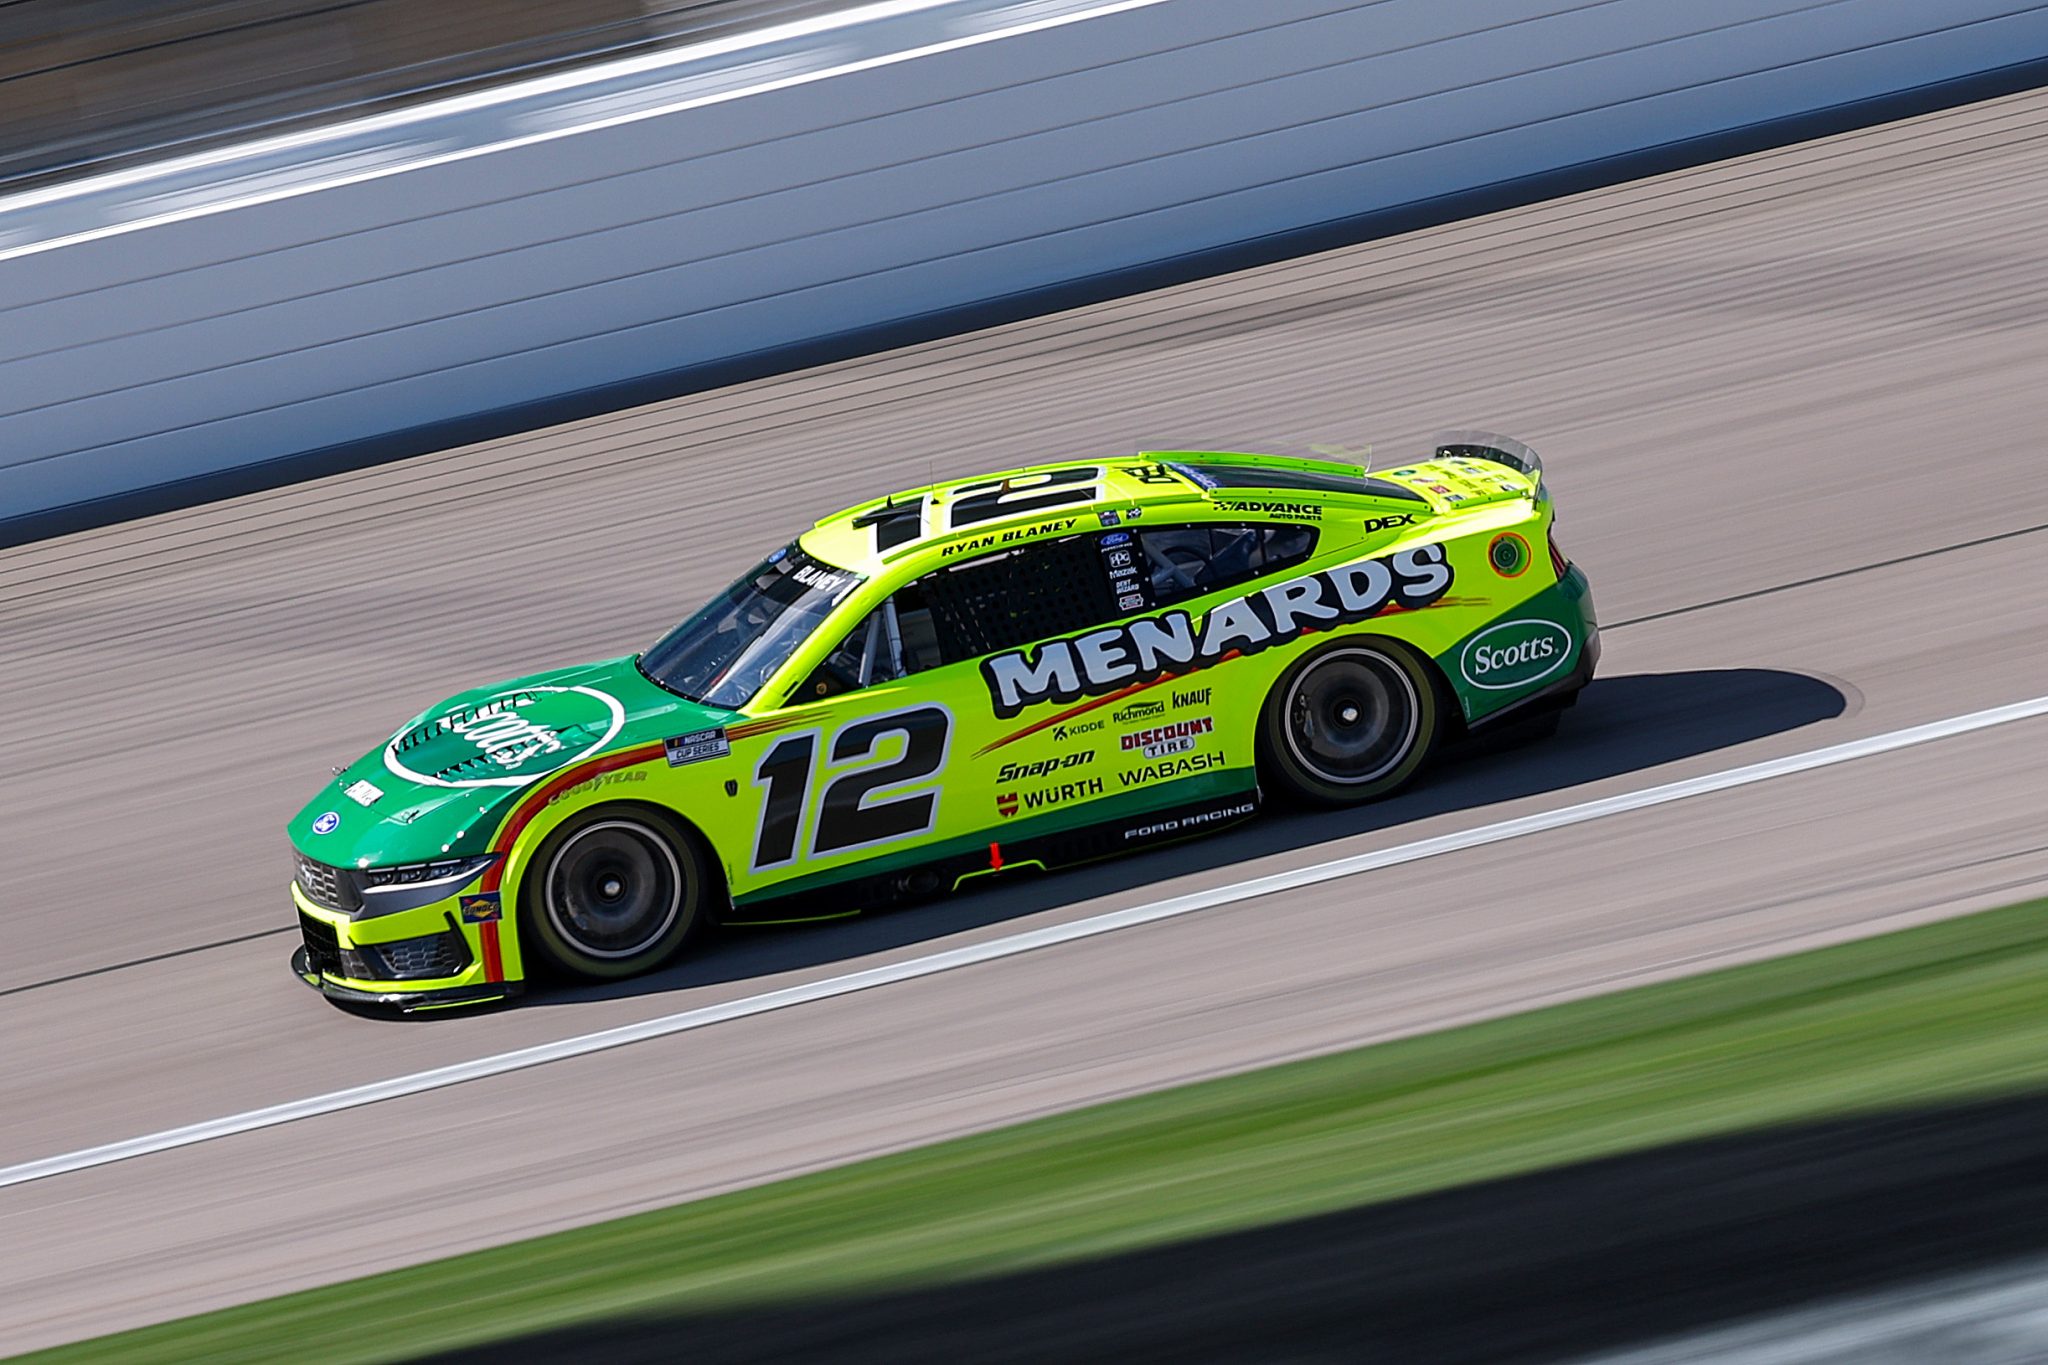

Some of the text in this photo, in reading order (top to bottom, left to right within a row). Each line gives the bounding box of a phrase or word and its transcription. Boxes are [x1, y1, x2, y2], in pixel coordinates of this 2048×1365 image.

[1234, 501, 1323, 515] ADVANCE
[1295, 513, 1322, 521] PARTS
[941, 535, 995, 557] RYAN
[1001, 518, 1077, 543] BLANEY
[1363, 513, 1416, 533] DEX
[792, 565, 846, 592] BLANEY
[984, 543, 1453, 714] MENARDS
[1474, 636, 1554, 675] Scotts
[1113, 700, 1165, 723] Richmond
[1172, 687, 1212, 709] KNAUF
[684, 730, 717, 744] NASCAR
[1069, 720, 1105, 737] KIDDE
[1120, 716, 1214, 751] DISCOUNT
[676, 742, 720, 759] CUP SERIES
[1147, 738, 1191, 758] TIRE
[995, 750, 1096, 785] Snap-on
[1118, 750, 1226, 786] WABASH
[548, 770, 648, 806] GOODYEAR
[750, 703, 954, 873] 12
[1024, 777, 1104, 808] WÜRTH
[1124, 803, 1254, 840] FORD RACING
